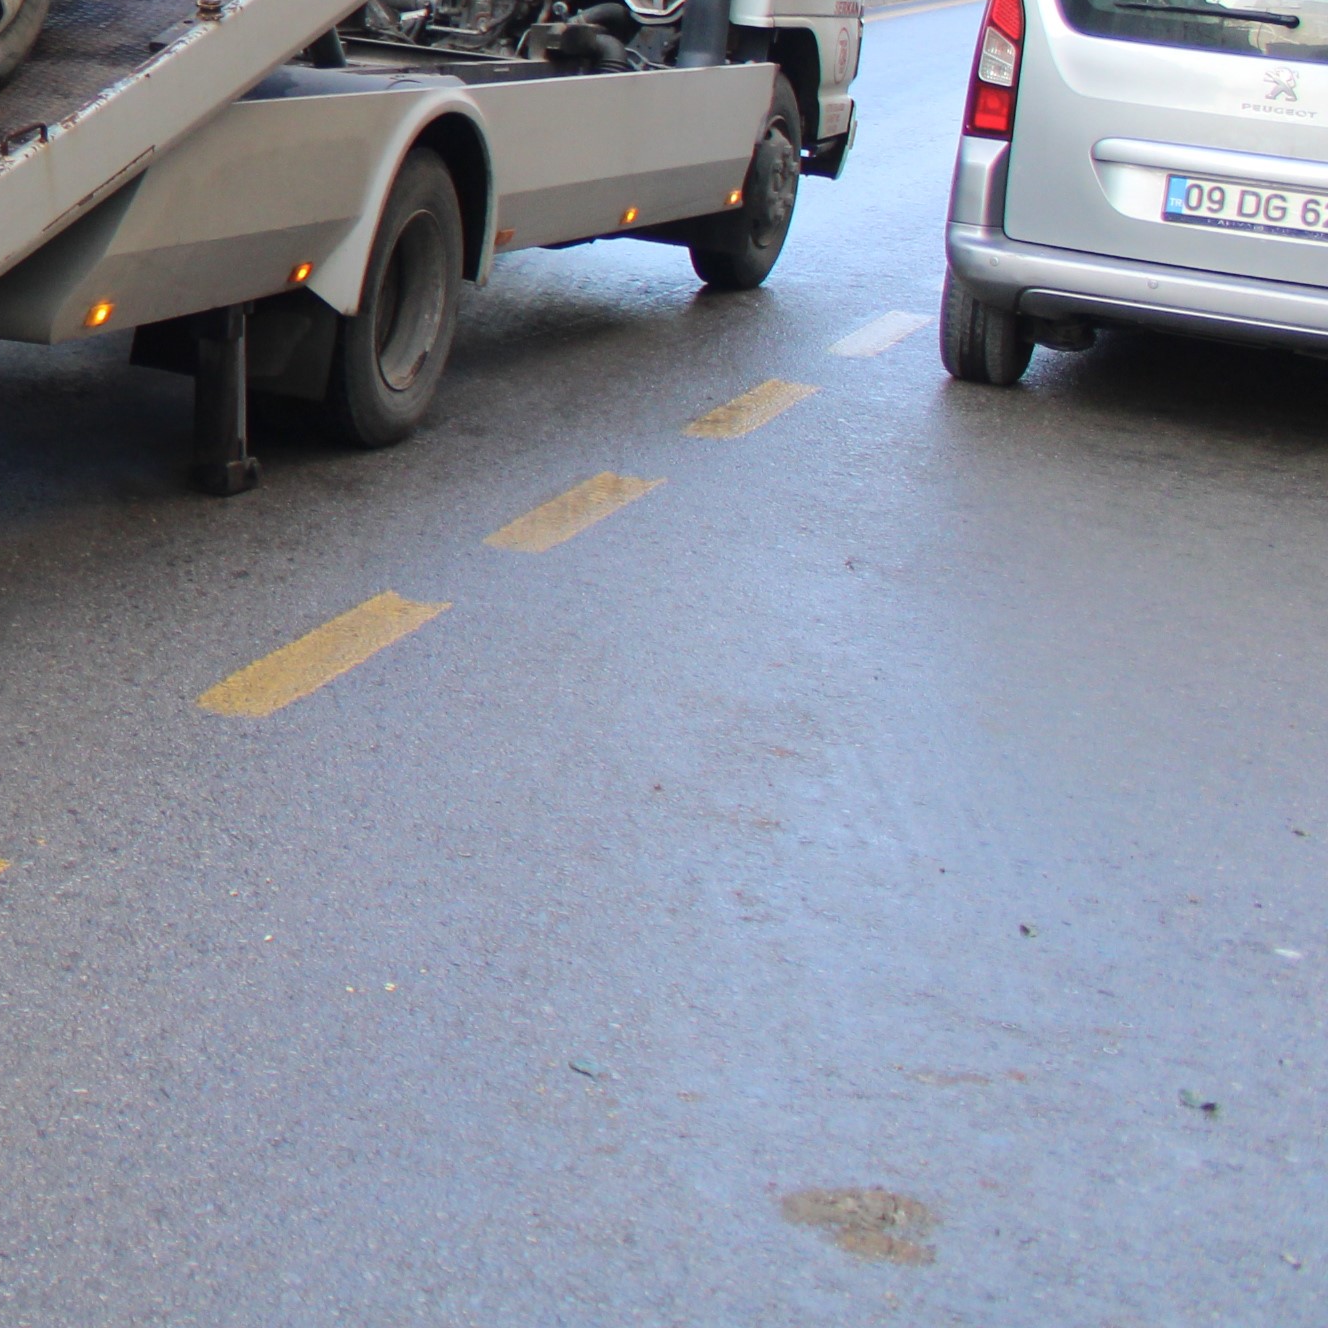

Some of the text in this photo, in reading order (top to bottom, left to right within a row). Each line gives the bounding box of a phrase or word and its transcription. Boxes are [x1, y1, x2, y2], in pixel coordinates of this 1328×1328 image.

[1240, 102, 1319, 119] PEUGEOT
[1169, 196, 1183, 207] TR
[1183, 182, 1226, 214] 09
[1236, 188, 1288, 223] DG
